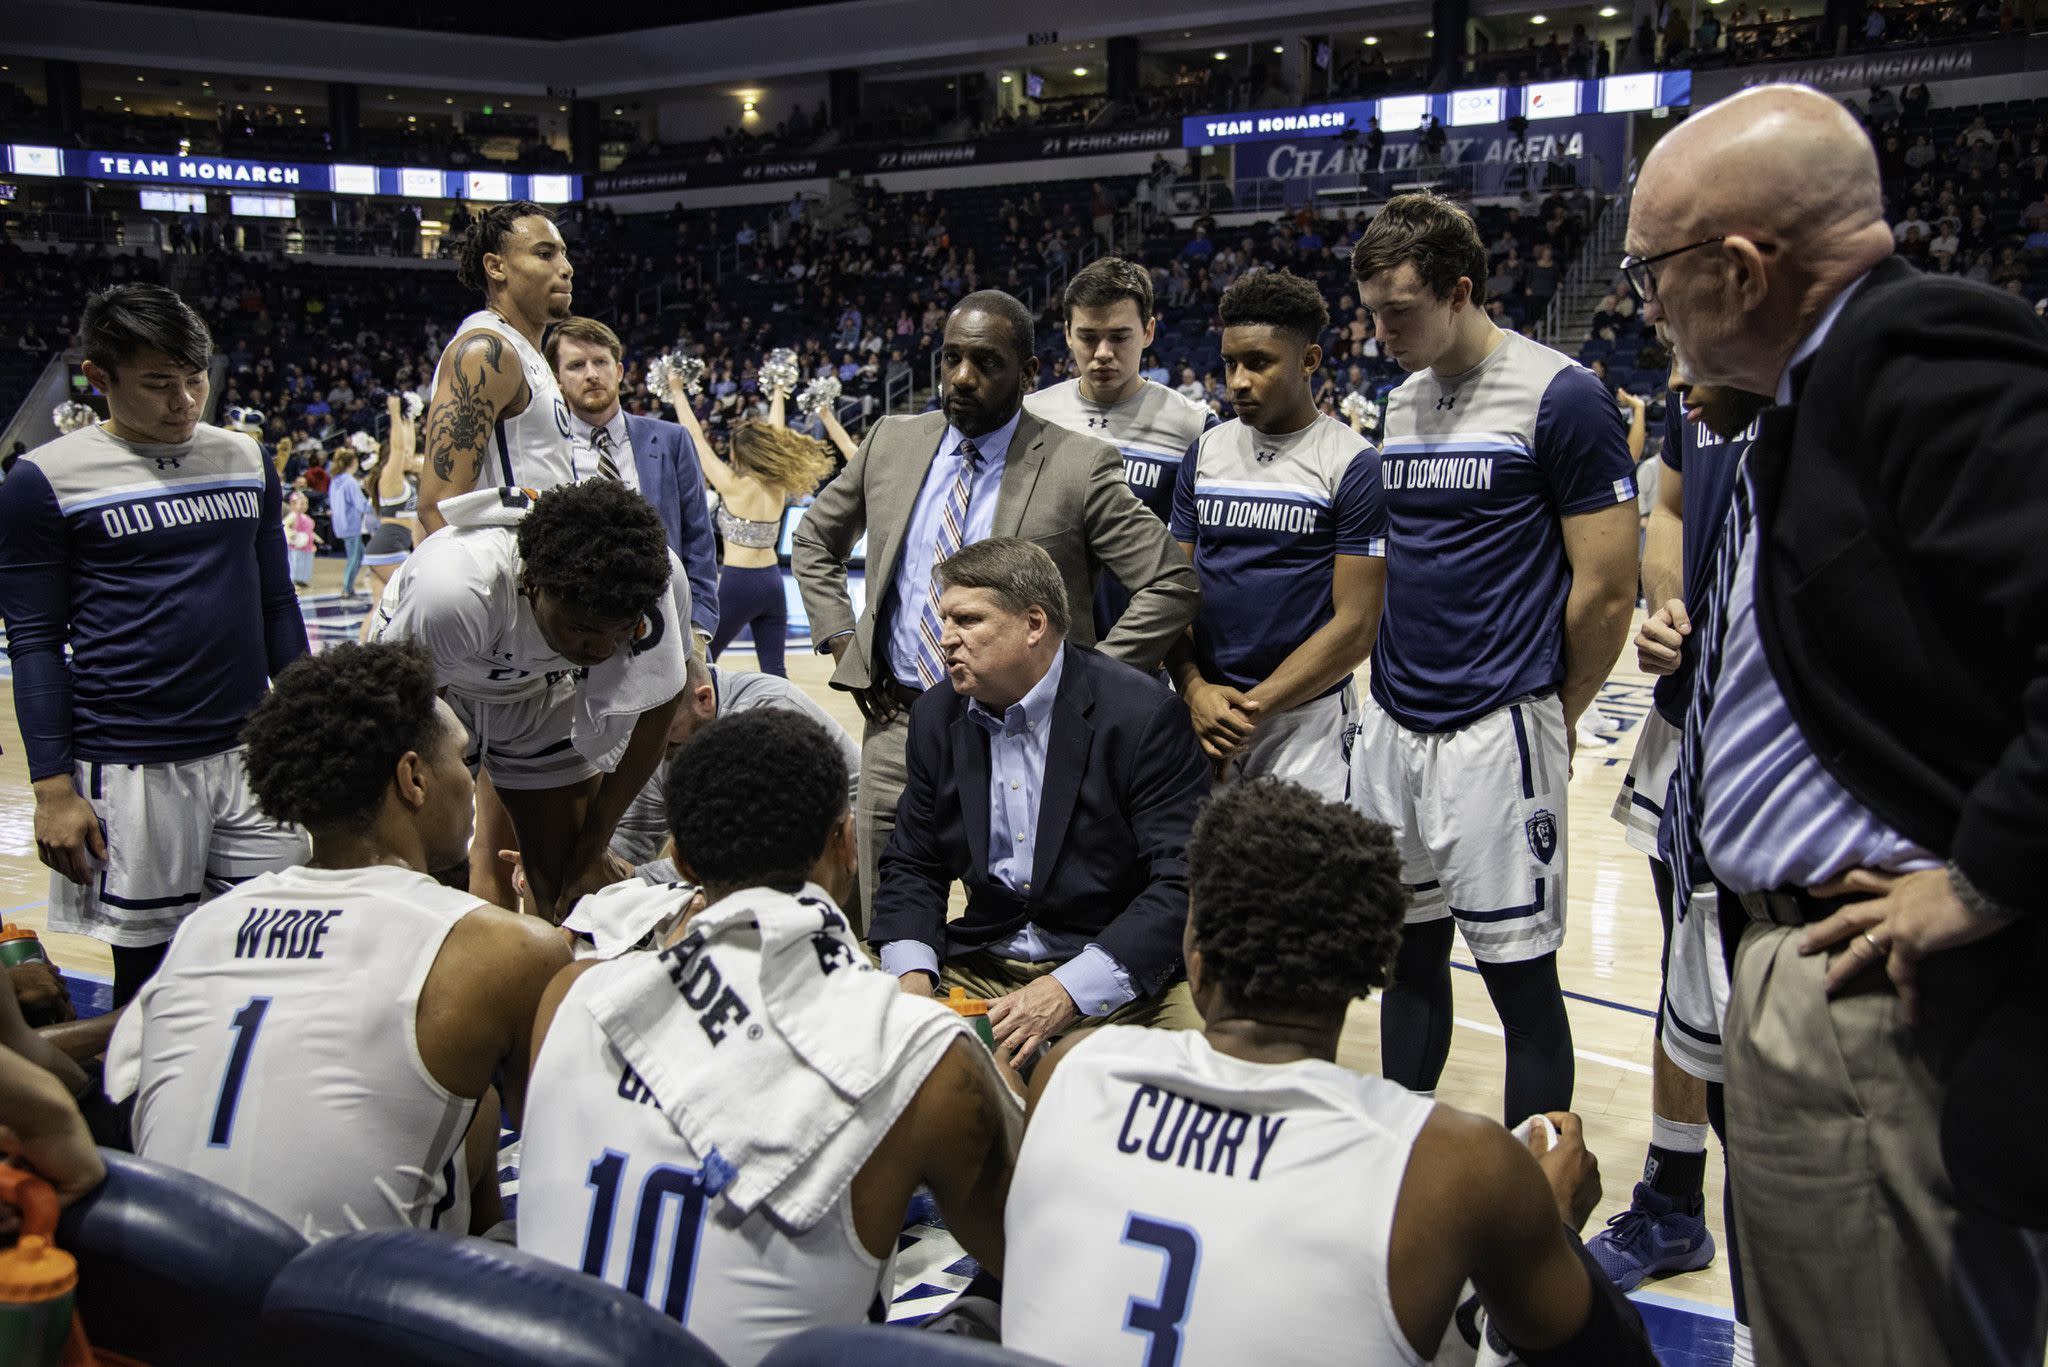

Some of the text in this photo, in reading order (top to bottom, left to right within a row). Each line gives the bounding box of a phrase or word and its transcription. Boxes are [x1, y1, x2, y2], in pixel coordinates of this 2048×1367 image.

[1205, 112, 1345, 137] TEAM MONARCH
[1482, 132, 1584, 164] ARENA
[99, 157, 300, 185] TEAM MONARCH
[1381, 457, 1493, 490] OLD DOMINION
[101, 491, 260, 538] OLD DOMINION
[1196, 499, 1318, 535] OLD DOMINION
[234, 907, 344, 959] WADE
[207, 994, 274, 1150] 1
[1116, 1082, 1287, 1181] CURRY
[579, 1146, 709, 1328] 10
[1119, 1209, 1203, 1367] 3
